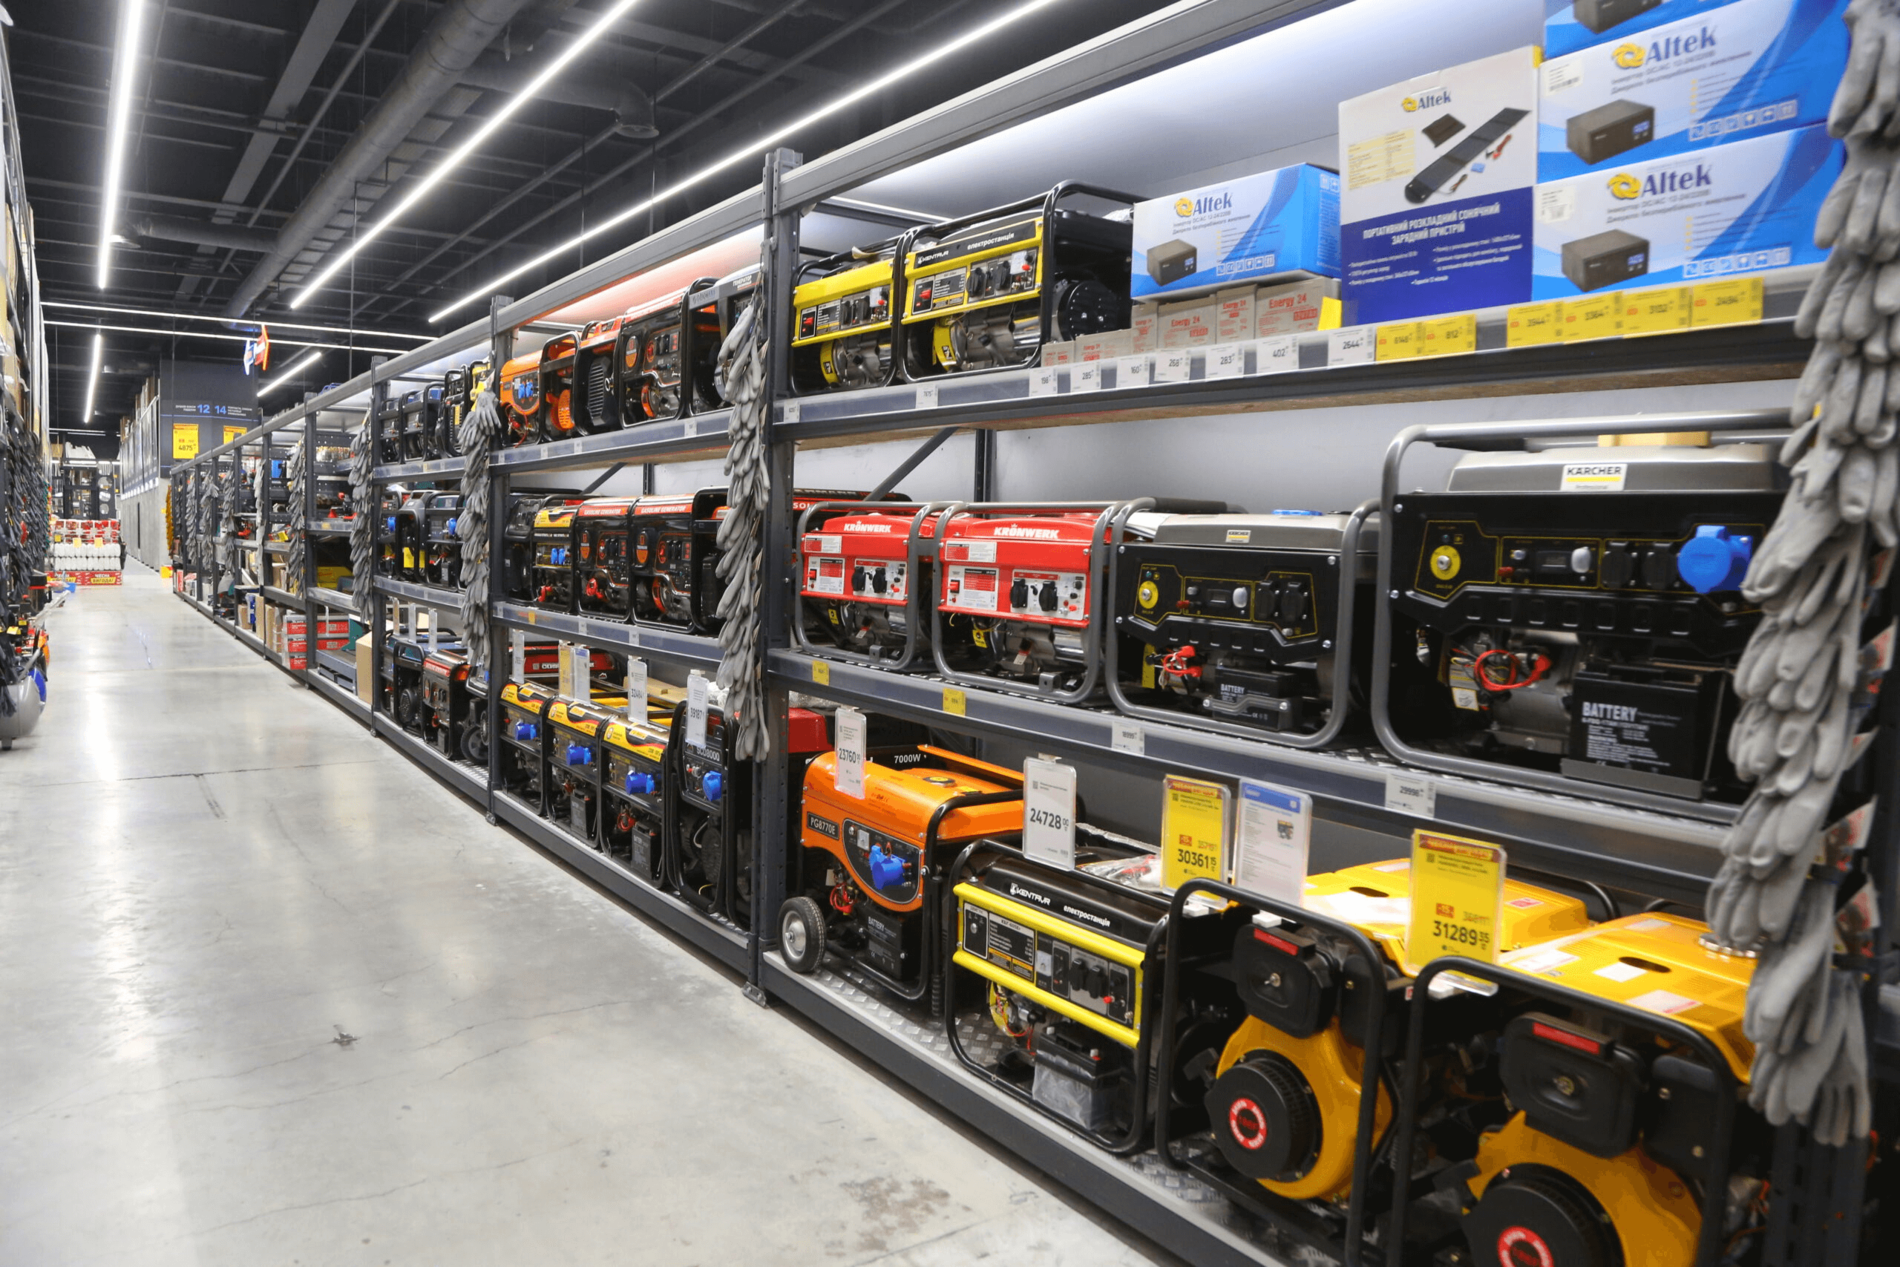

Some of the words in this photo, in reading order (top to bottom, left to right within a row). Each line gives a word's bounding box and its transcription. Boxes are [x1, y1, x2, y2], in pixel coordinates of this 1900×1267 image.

[1647, 26, 1717, 64] Altek
[1417, 91, 1452, 111] Altek
[1642, 163, 1713, 198] Altek
[1193, 192, 1233, 216] Altek
[1363, 219, 1409, 240] ПОРТАТИВНИЙ
[1409, 209, 1458, 230] РОЗКЛАДНИЙ
[1458, 201, 1501, 220] СОНЯЧНИЙ
[967, 231, 1015, 250] електростанція
[1391, 227, 1429, 246] ЗАРЯДНИЙ
[1429, 221, 1466, 239] ПРИСТРІЙ
[1269, 295, 1295, 309] Energy
[1171, 317, 1190, 328] Energy
[1272, 349, 1287, 359] 402
[1342, 341, 1361, 351] 2644
[1220, 355, 1233, 366] 283
[197, 404, 211, 414] 12
[214, 405, 227, 415] 14
[1567, 465, 1622, 476] KÄRCHER
[641, 506, 661, 514] GASOLINE
[661, 505, 686, 513] GENERATOR
[1221, 684, 1245, 695] BATTERY
[1582, 702, 1638, 722] BATTERY
[894, 753, 921, 764] 7000W
[1030, 808, 1062, 830] 24728
[1177, 848, 1209, 869] 30361
[1063, 904, 1111, 928] електростанція
[1432, 920, 1478, 946] 31289
